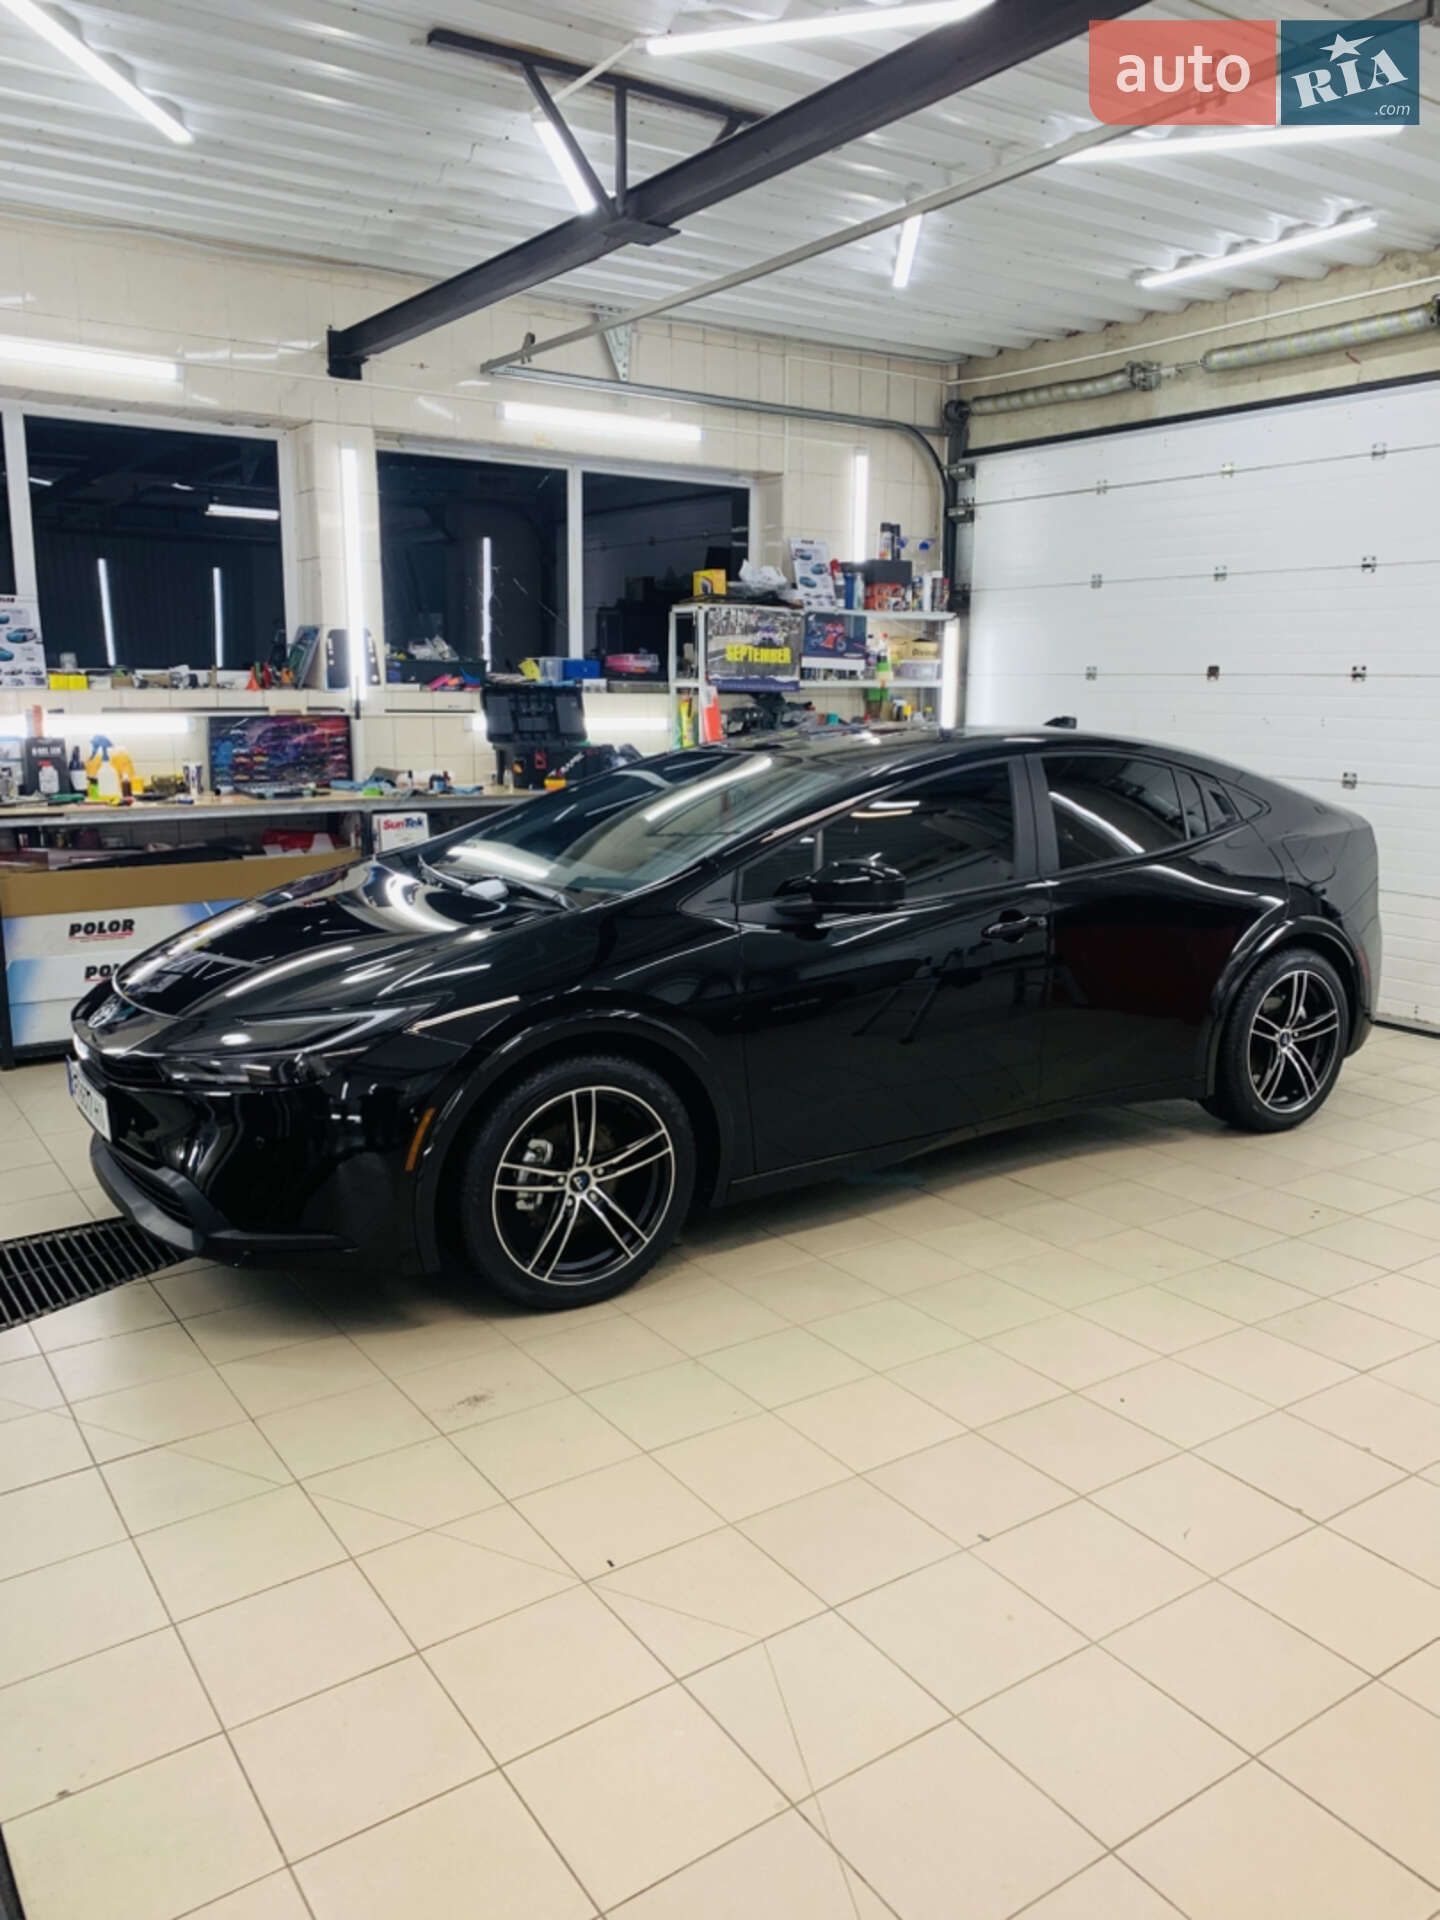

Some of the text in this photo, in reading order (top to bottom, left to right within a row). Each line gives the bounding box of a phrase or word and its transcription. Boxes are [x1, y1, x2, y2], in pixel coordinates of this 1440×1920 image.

[725, 643, 792, 664] SEPTEMBER
[383, 815, 424, 830] SunTek
[69, 918, 134, 936] POLOR
